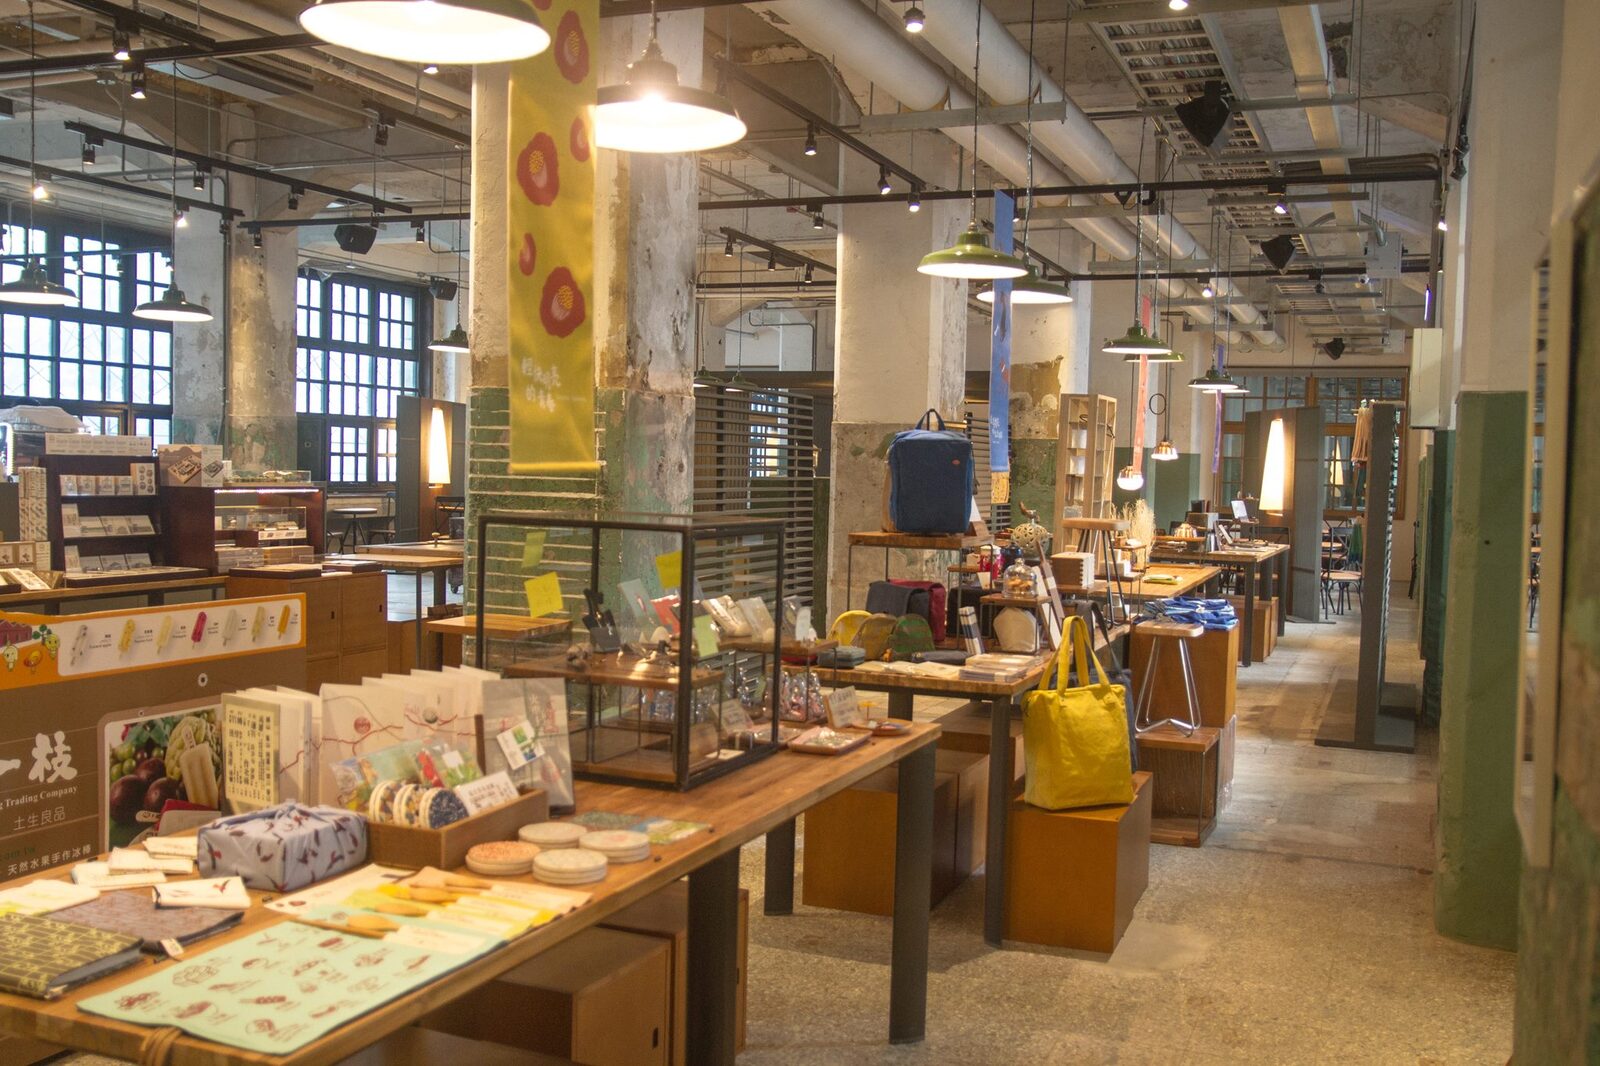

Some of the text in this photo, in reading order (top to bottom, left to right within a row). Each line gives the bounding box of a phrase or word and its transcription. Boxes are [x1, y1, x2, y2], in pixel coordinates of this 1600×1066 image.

[5, 795, 38, 807] Trading
[40, 786, 77, 799] Company
[14, 806, 65, 830] 土生良品
[8, 844, 91, 875] 天然水果手作冰棒
